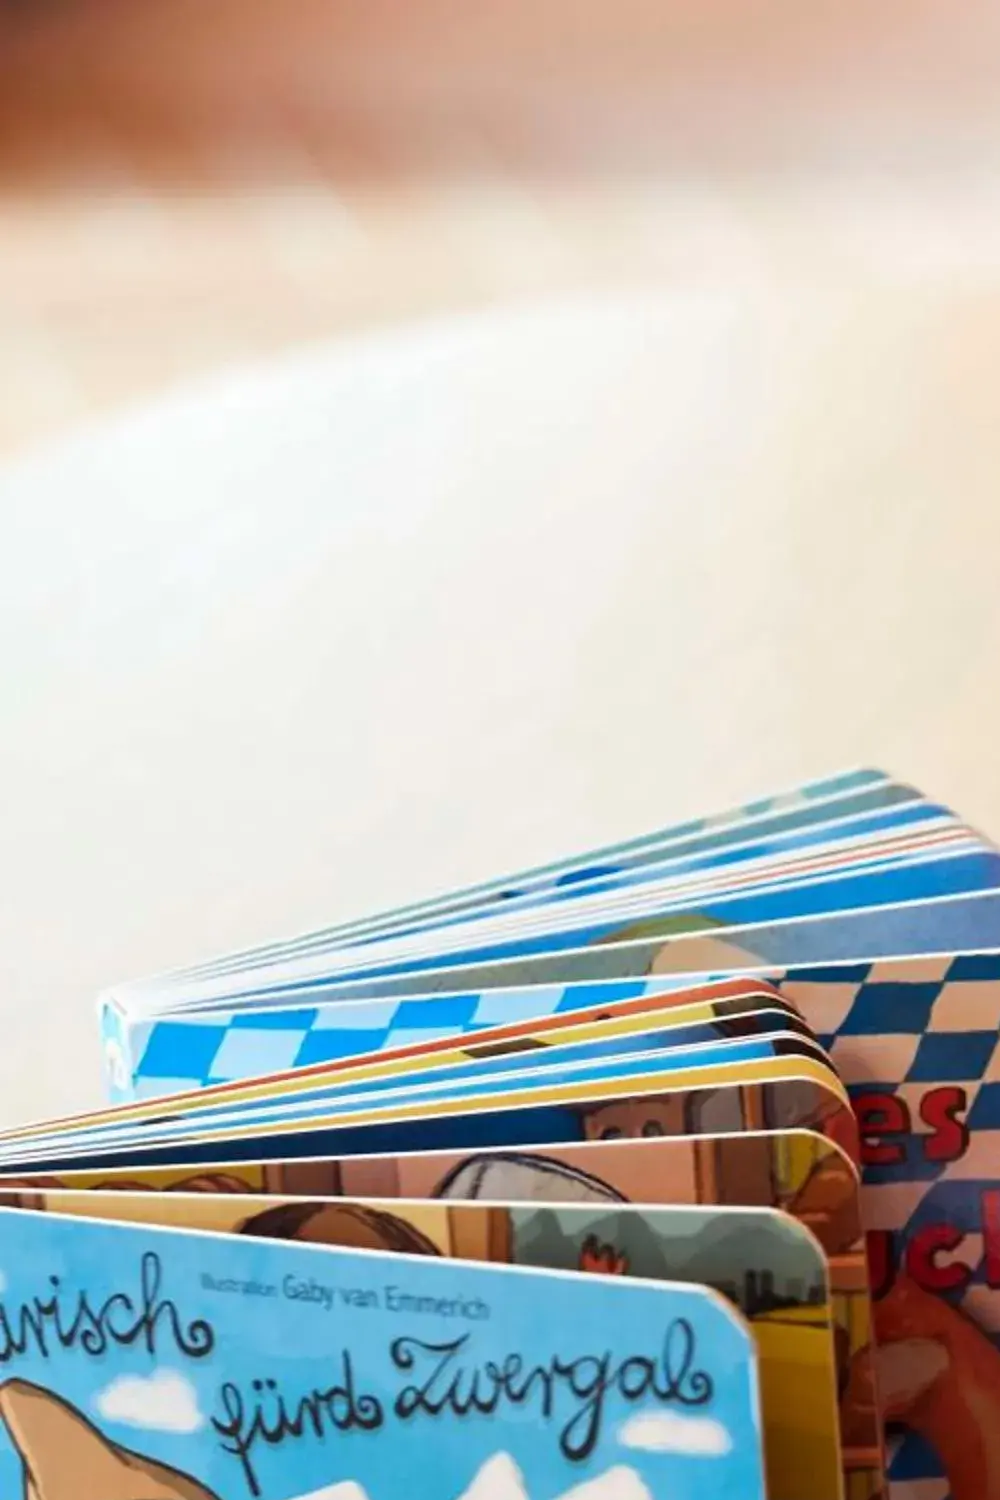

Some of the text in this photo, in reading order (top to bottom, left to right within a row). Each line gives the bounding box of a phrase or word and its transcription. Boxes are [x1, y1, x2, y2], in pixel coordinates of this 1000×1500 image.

[282, 1274, 333, 1311] Gaby
[341, 1287, 378, 1308] van
[384, 1285, 491, 1321] Emmerich
